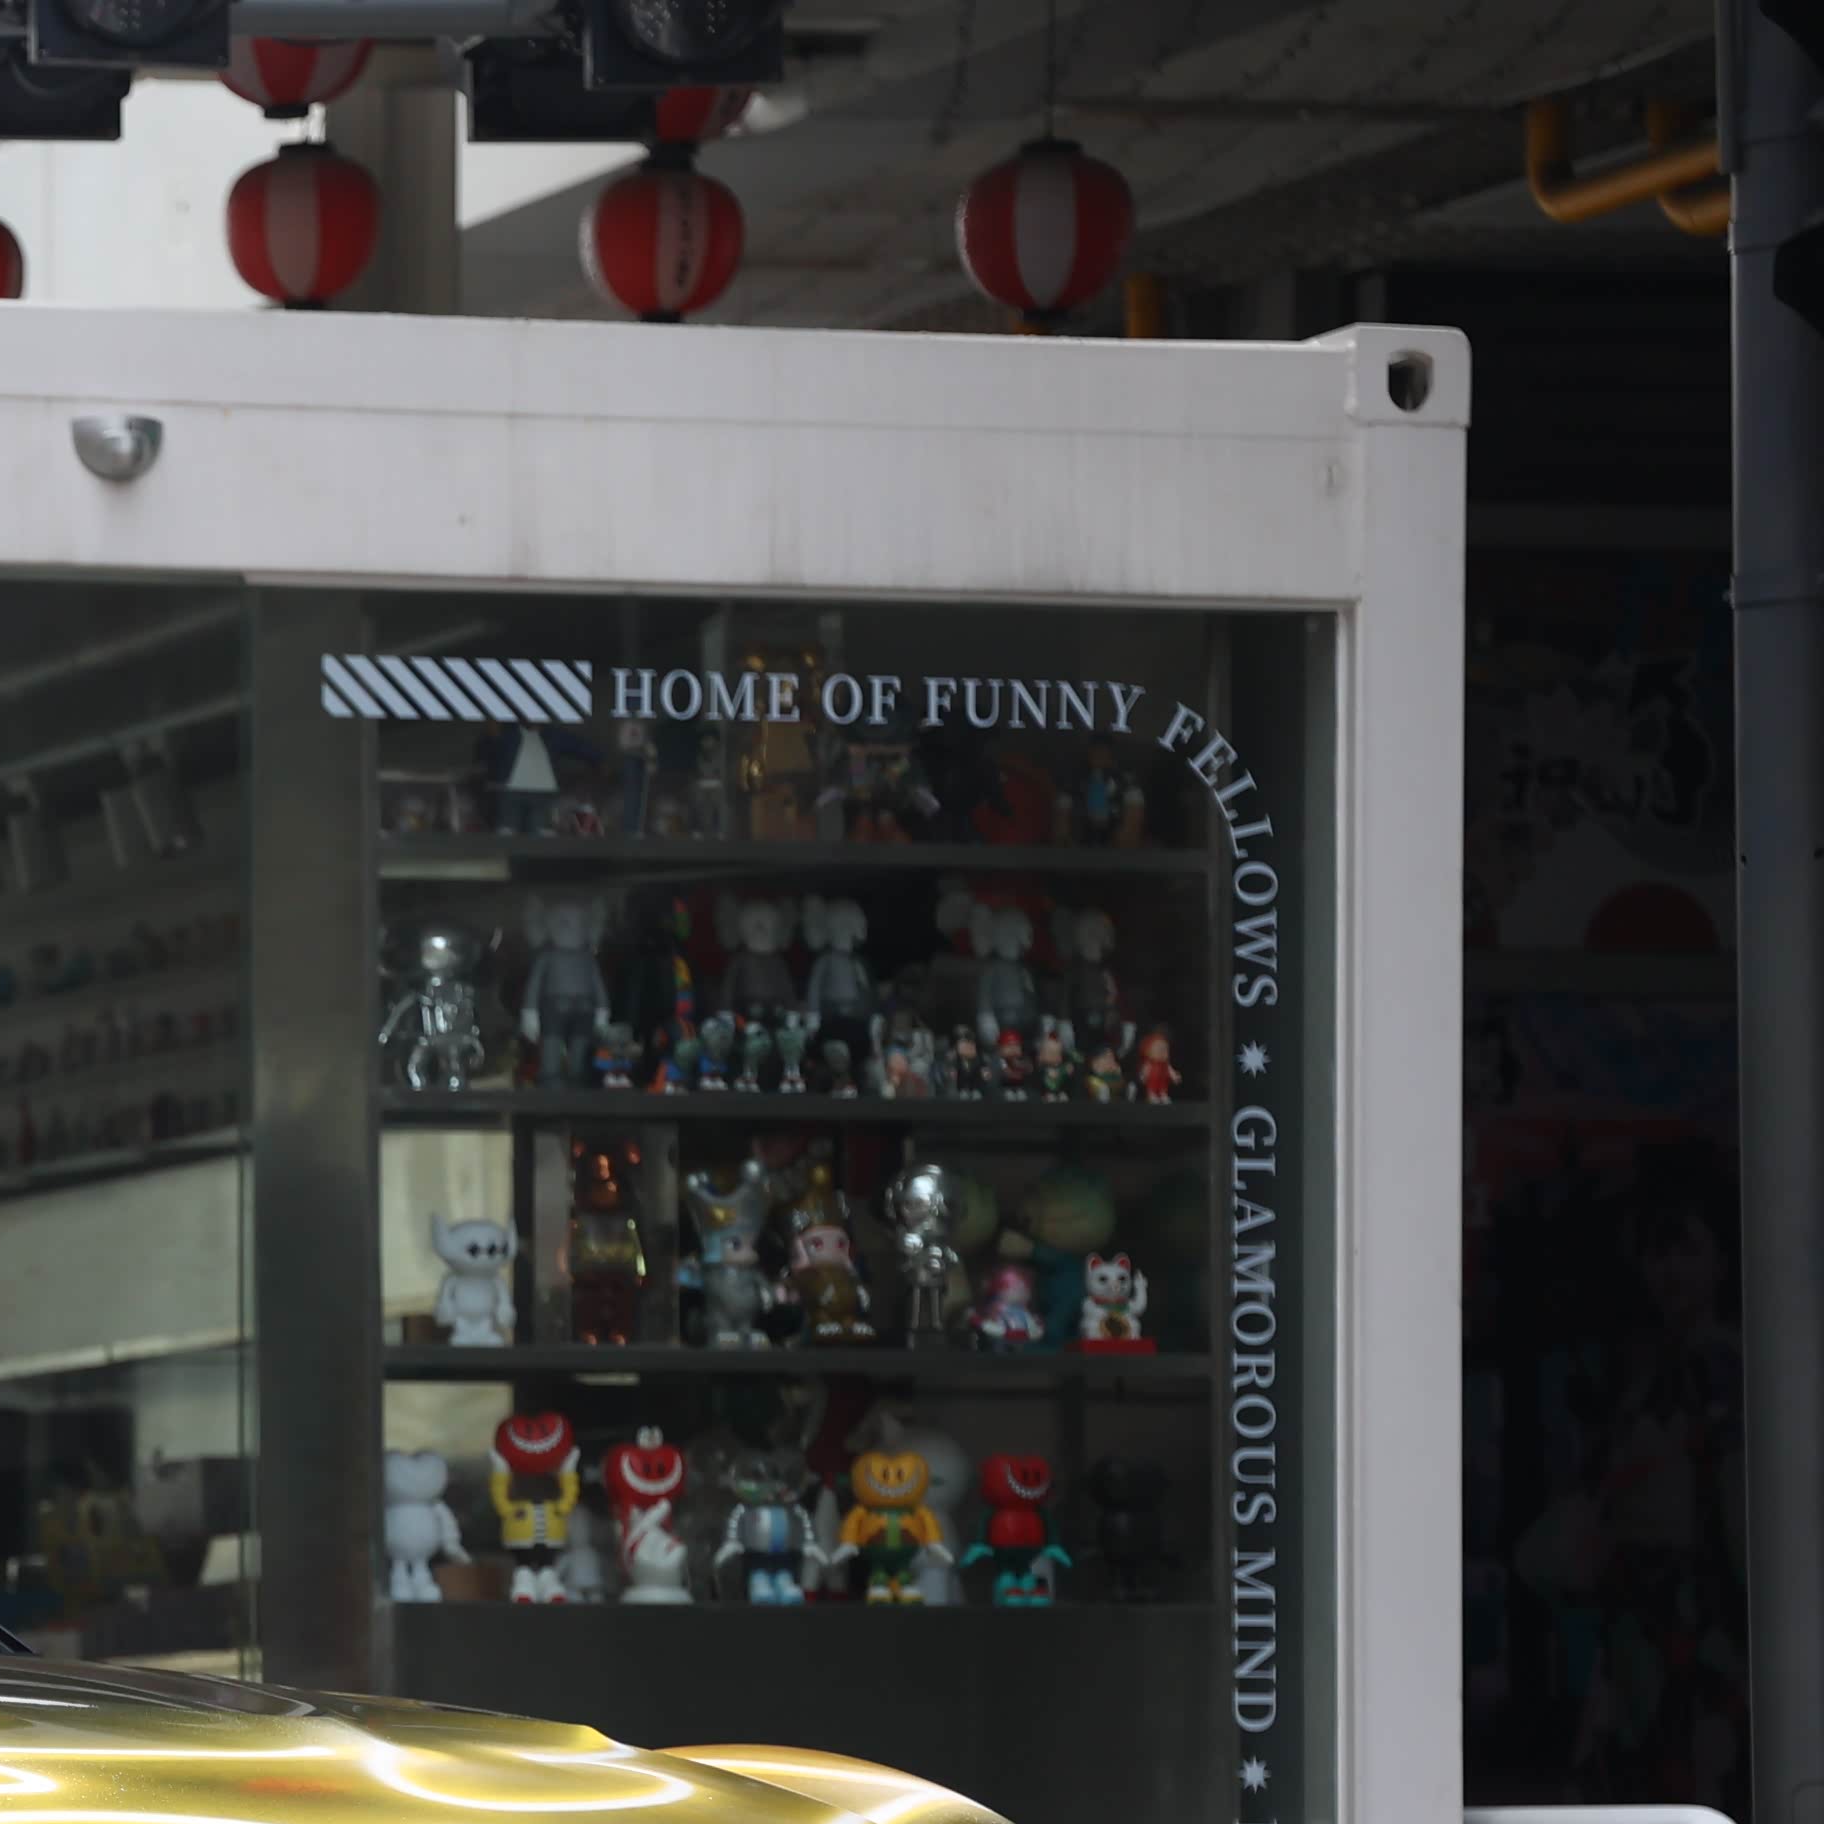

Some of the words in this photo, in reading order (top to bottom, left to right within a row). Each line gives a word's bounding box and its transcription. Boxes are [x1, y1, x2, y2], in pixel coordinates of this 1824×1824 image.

[611, 667, 801, 722] HOME
[823, 673, 901, 725] OF
[924, 676, 1145, 734] FUNNY
[1157, 701, 1280, 1009] FELLOWS
[1231, 1106, 1278, 1527] GLAMOROUS
[1232, 1549, 1278, 1735] MIND
